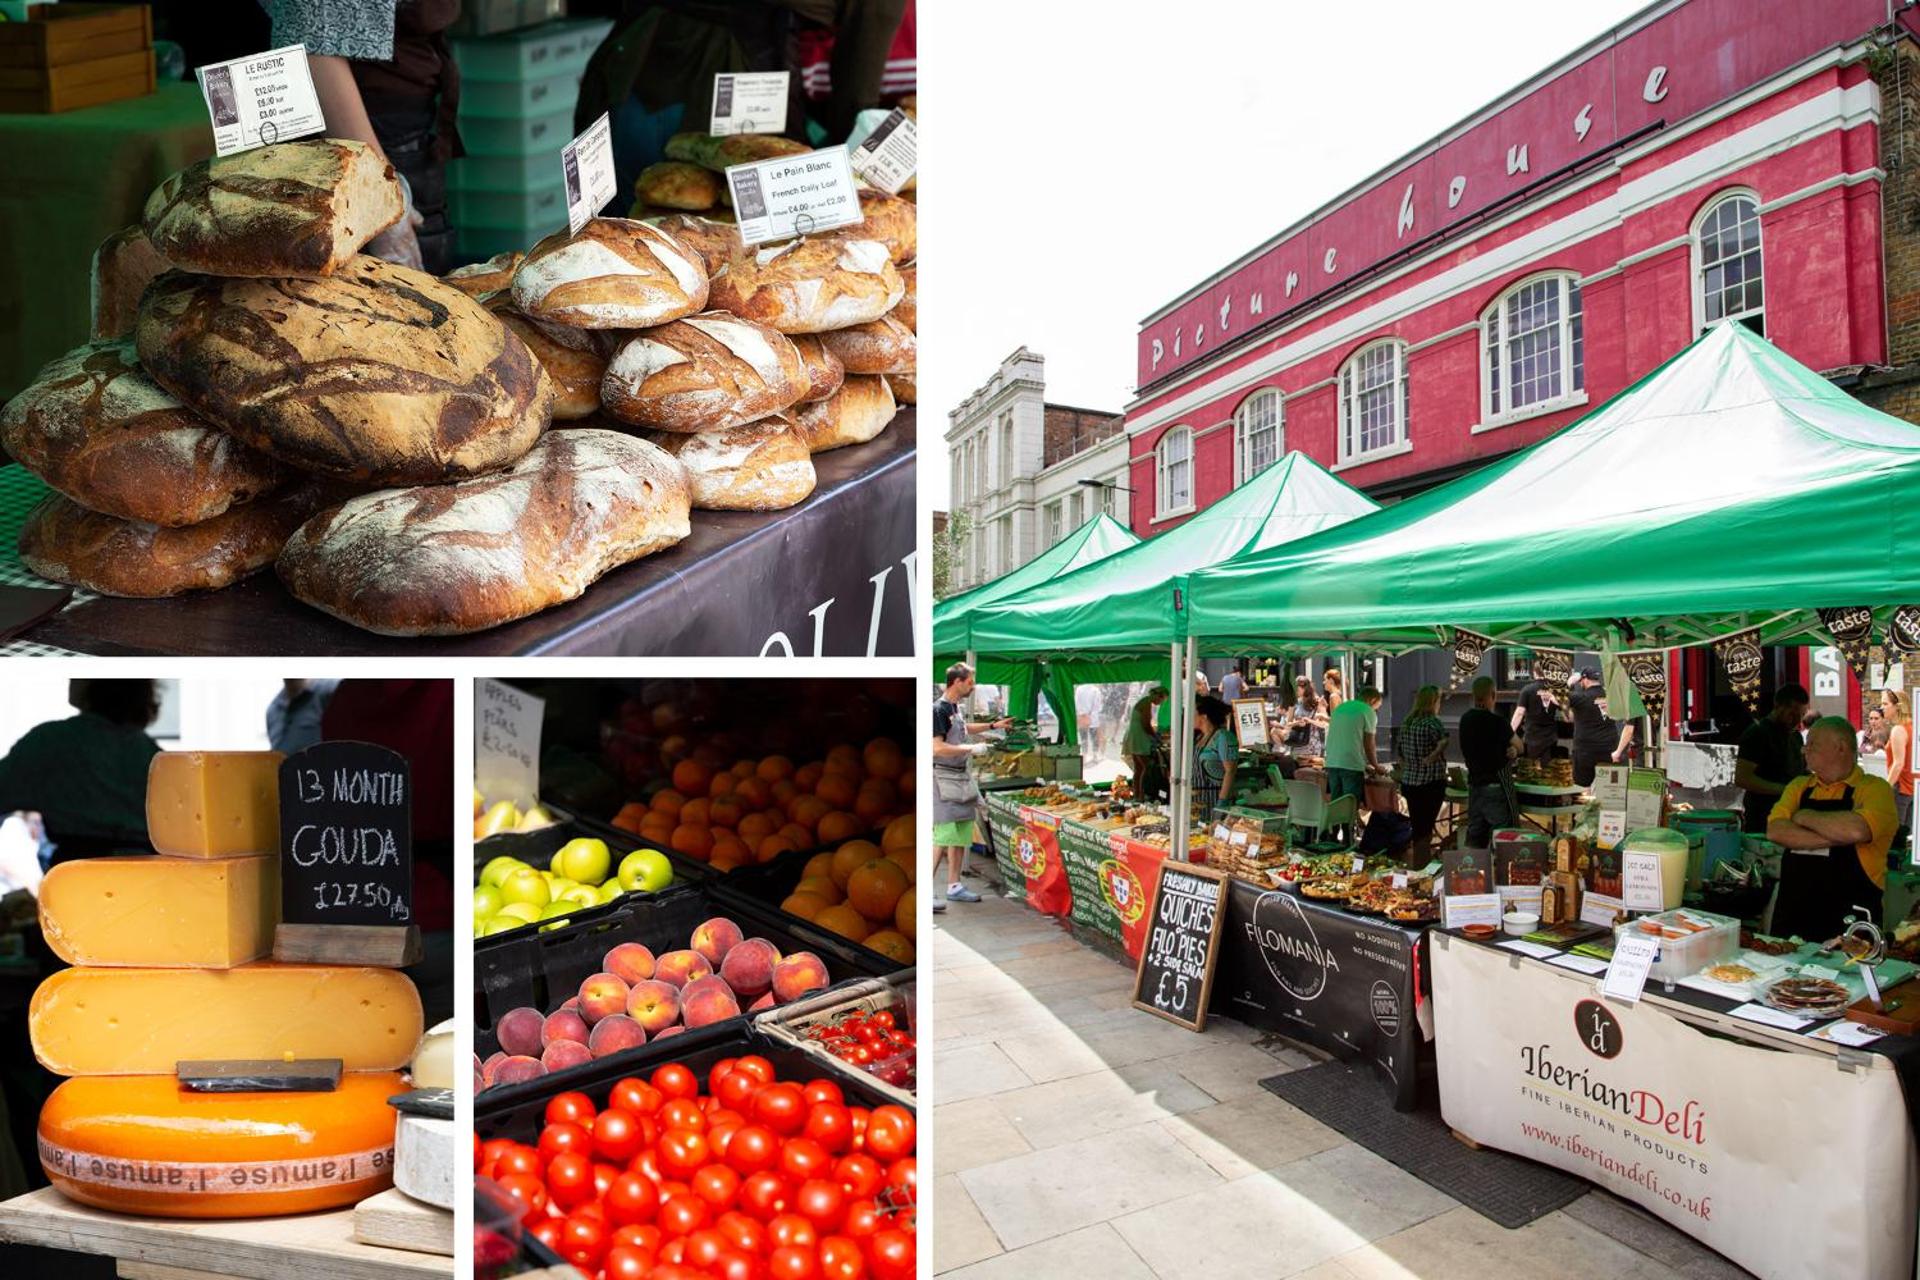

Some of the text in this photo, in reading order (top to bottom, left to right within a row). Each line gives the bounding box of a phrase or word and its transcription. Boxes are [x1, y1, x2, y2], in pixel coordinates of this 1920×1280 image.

[245, 57, 284, 74] LE RUSTIC
[1397, 66, 1669, 239] house
[770, 161, 832, 180] Le Pain Blanc
[771, 179, 838, 199] French Daily Loaf
[1828, 610, 1871, 634] taste
[1455, 650, 1480, 665] taste
[1726, 656, 1761, 674] taste
[1632, 674, 1664, 684] taste
[1241, 712, 1260, 724] £15
[297, 768, 404, 806] 13 MONTH
[292, 825, 400, 867] GOUDA
[313, 882, 392, 910] £27.50
[1162, 872, 1196, 893] FRESHLY
[1160, 894, 1216, 934] QUICHES
[1151, 927, 1207, 966] FILO PIES
[1245, 922, 1340, 972] FILOMANIA
[1154, 954, 1162, 967] 2
[1162, 955, 1182, 973] SIDE
[1154, 970, 1190, 1011] £5
[1374, 1000, 1398, 1014] 100%
[1521, 1086, 1709, 1176] FINE IBERIAN PRODUCTS
[90, 1158, 207, 1192] l'amuse
[230, 1157, 356, 1187] l'amuse
[1521, 1120, 1712, 1221] www.iberiandeli.co.uk
